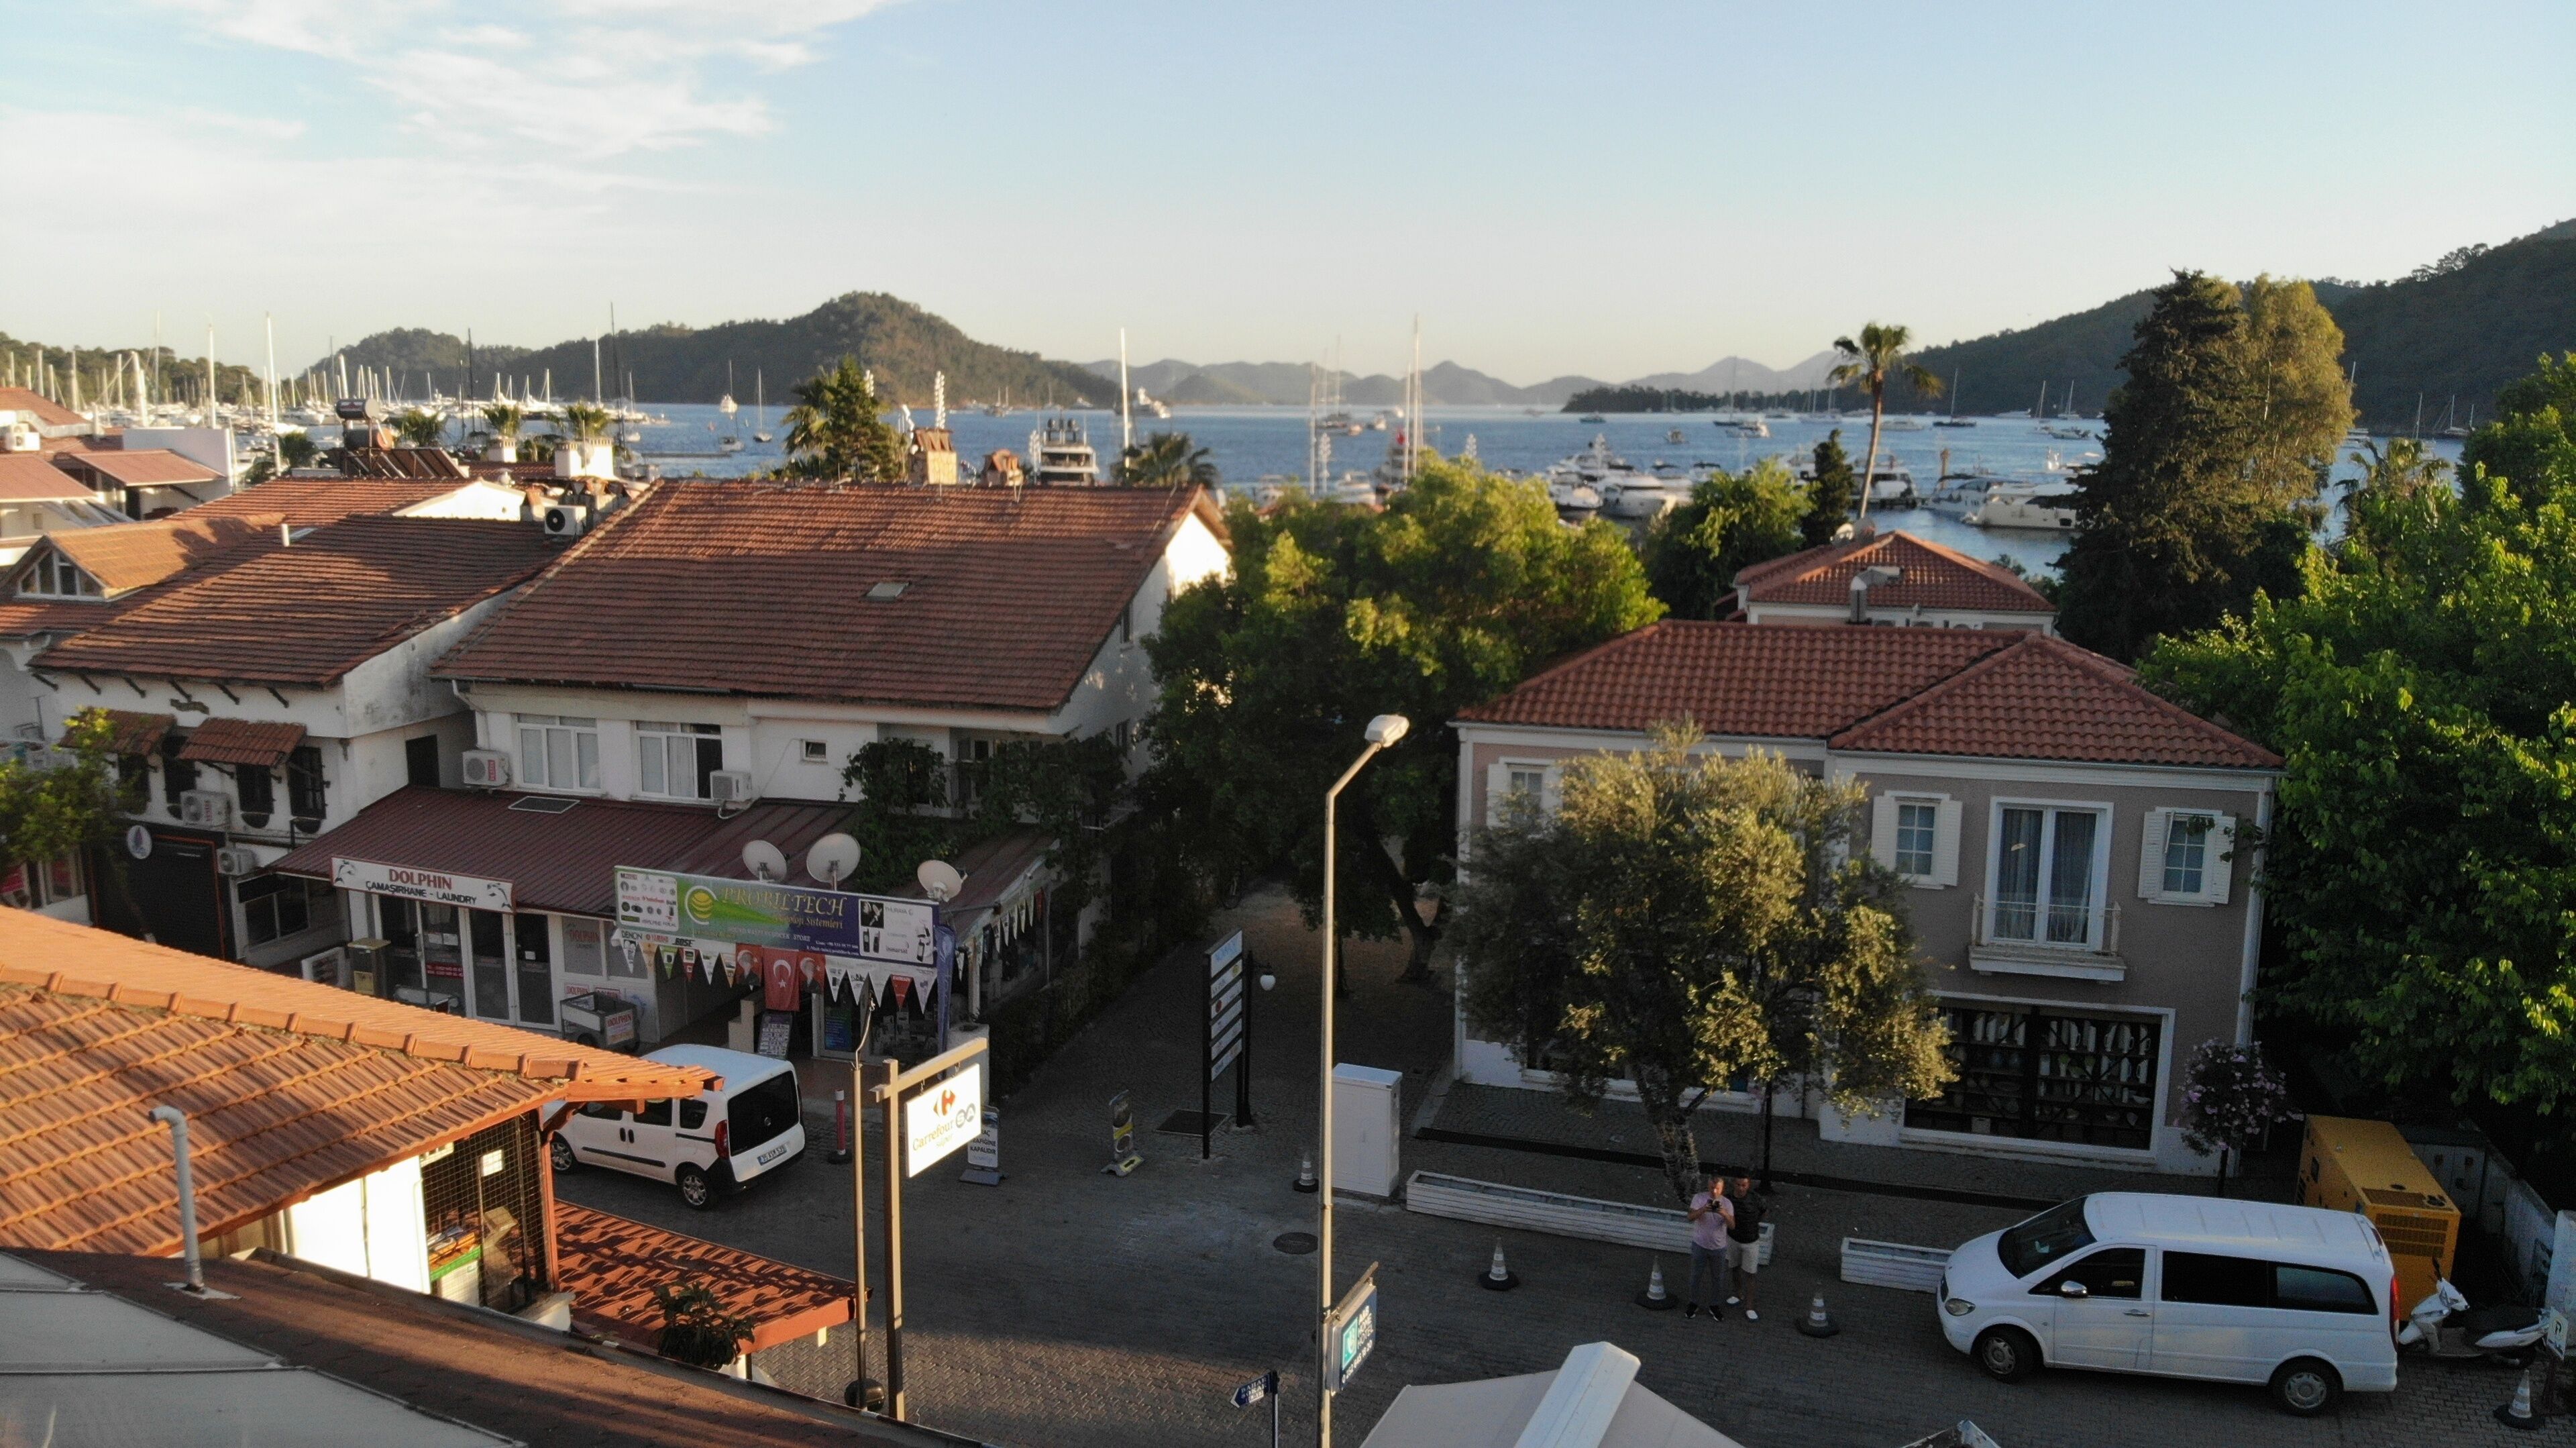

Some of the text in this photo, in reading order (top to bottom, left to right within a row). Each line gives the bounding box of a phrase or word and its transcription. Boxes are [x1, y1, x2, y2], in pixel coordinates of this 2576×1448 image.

[388, 868, 452, 890] DOLPHIN
[366, 880, 427, 897] ÇAMAŞIRHANE
[436, 891, 478, 905] LAUNDRY
[621, 930, 642, 939] DENON
